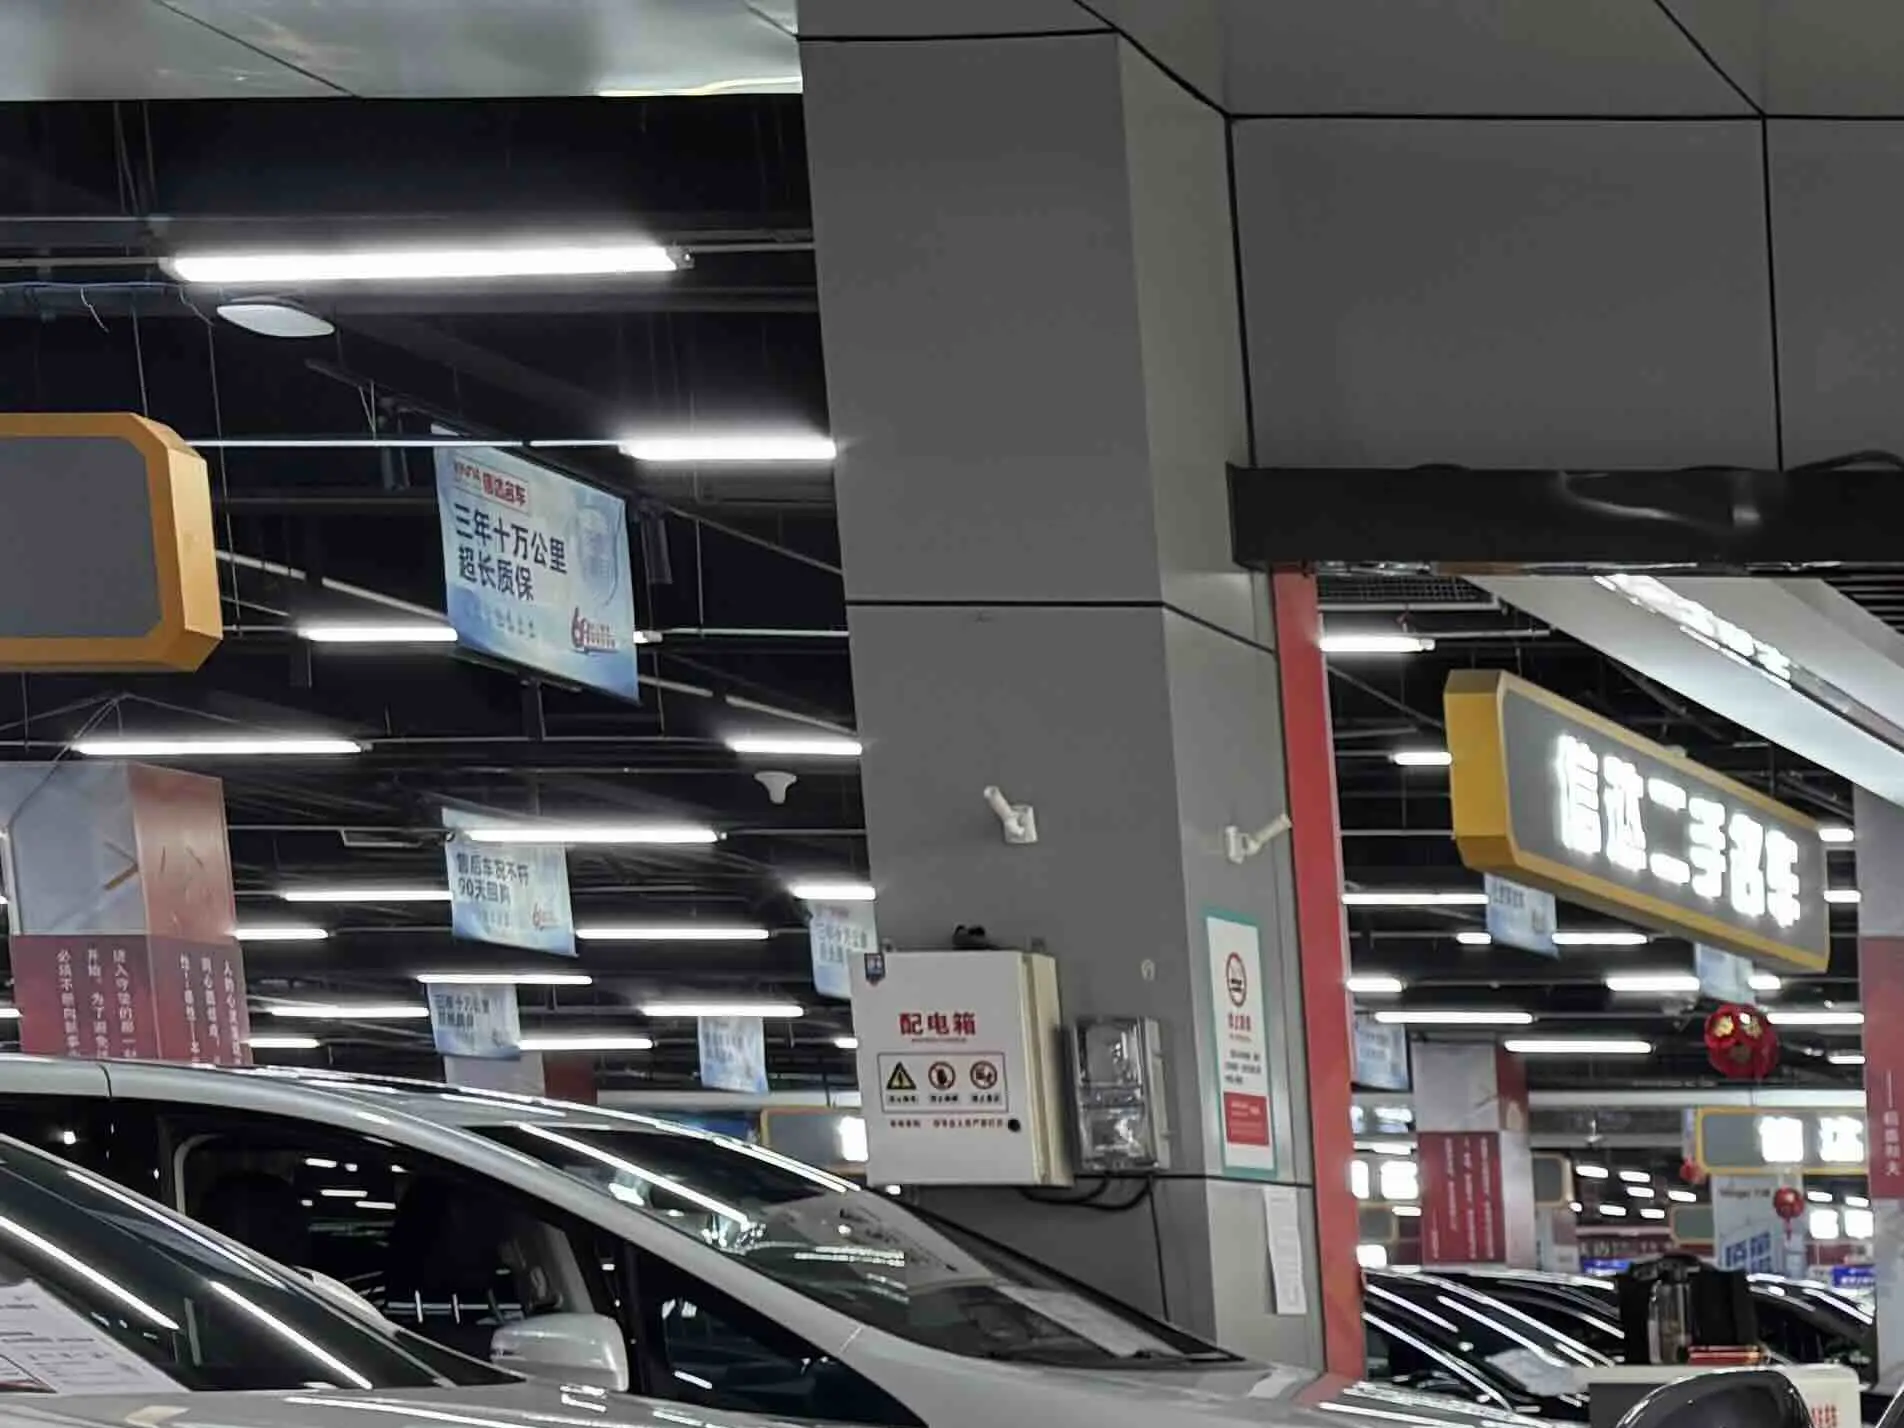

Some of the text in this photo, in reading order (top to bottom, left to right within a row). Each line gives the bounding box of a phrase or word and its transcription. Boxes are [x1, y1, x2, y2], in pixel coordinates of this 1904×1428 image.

[454, 502, 568, 575] 三年十万公里
[458, 545, 534, 601] 超长质保
[899, 1011, 978, 1037] 配电箱
